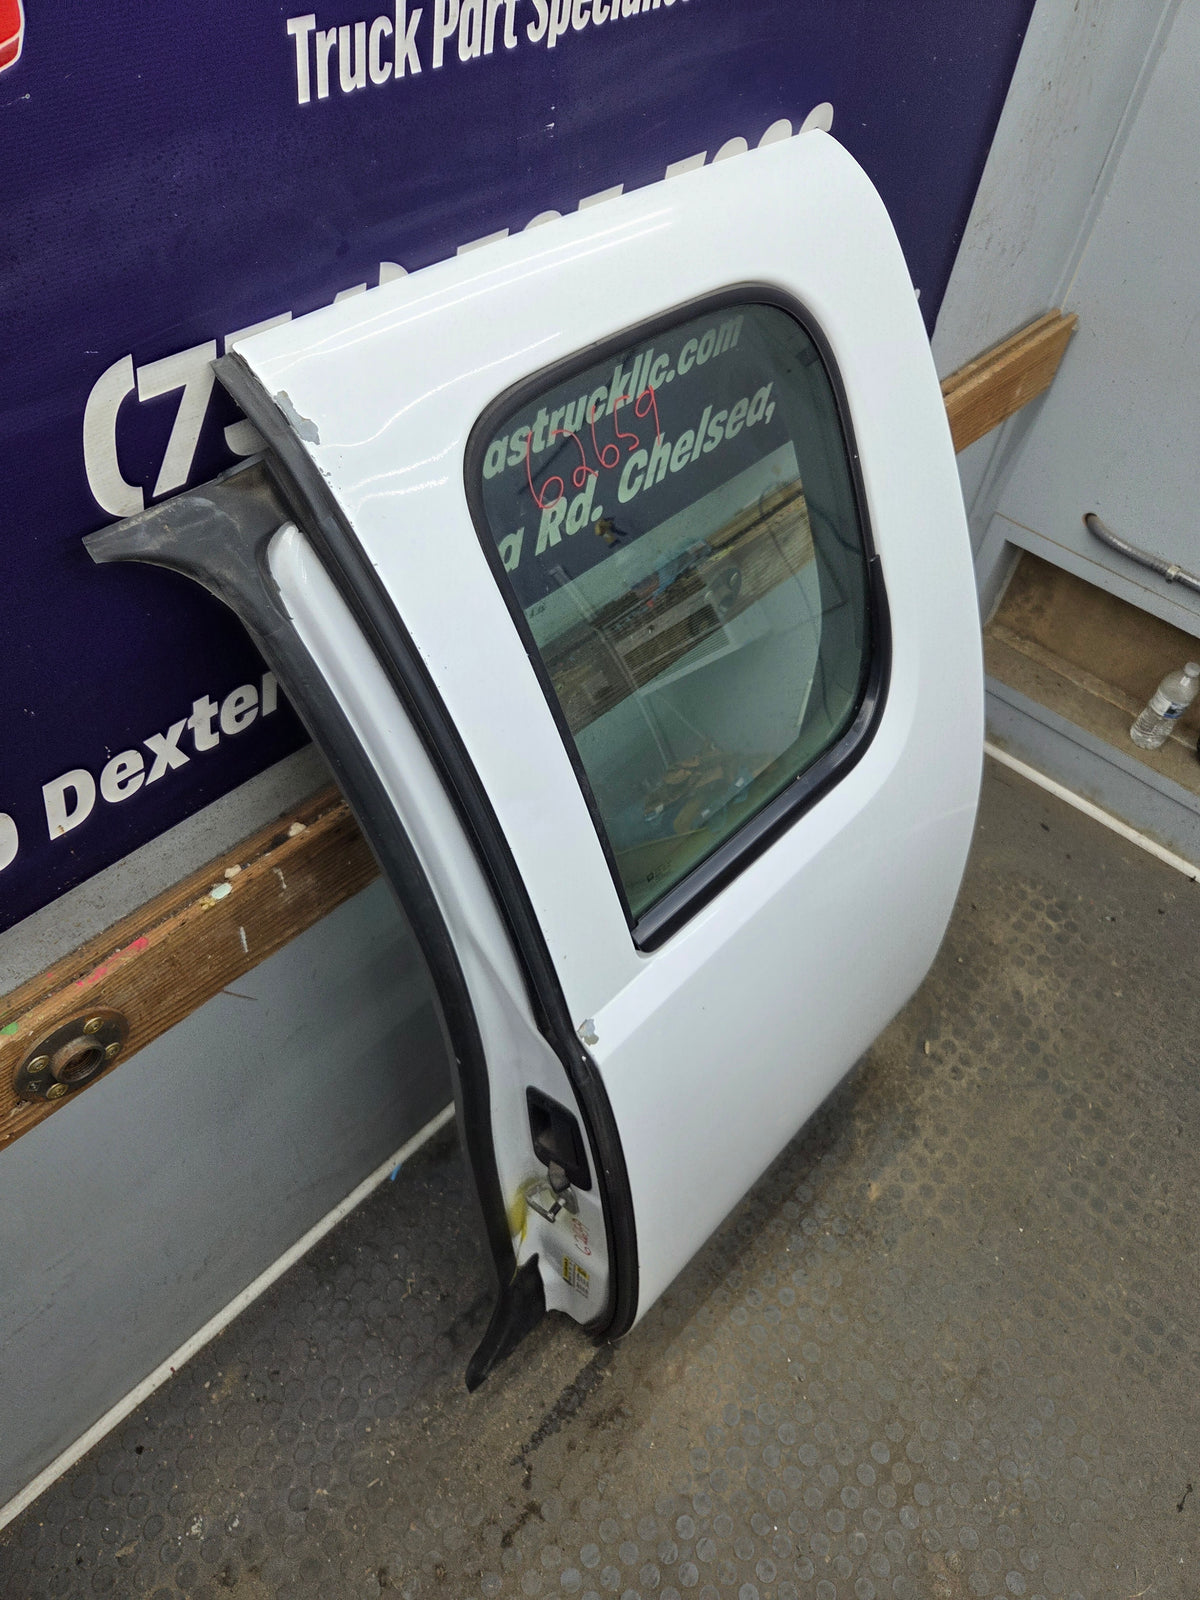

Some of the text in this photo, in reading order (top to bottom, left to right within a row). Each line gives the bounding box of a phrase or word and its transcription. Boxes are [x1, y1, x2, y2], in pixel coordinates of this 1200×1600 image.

[287, 0, 421, 104] Truck
[432, 0, 520, 68] Part
[526, 384, 661, 509] 62659
[535, 471, 603, 556] Rd.
[618, 382, 776, 504] Chelsea,
